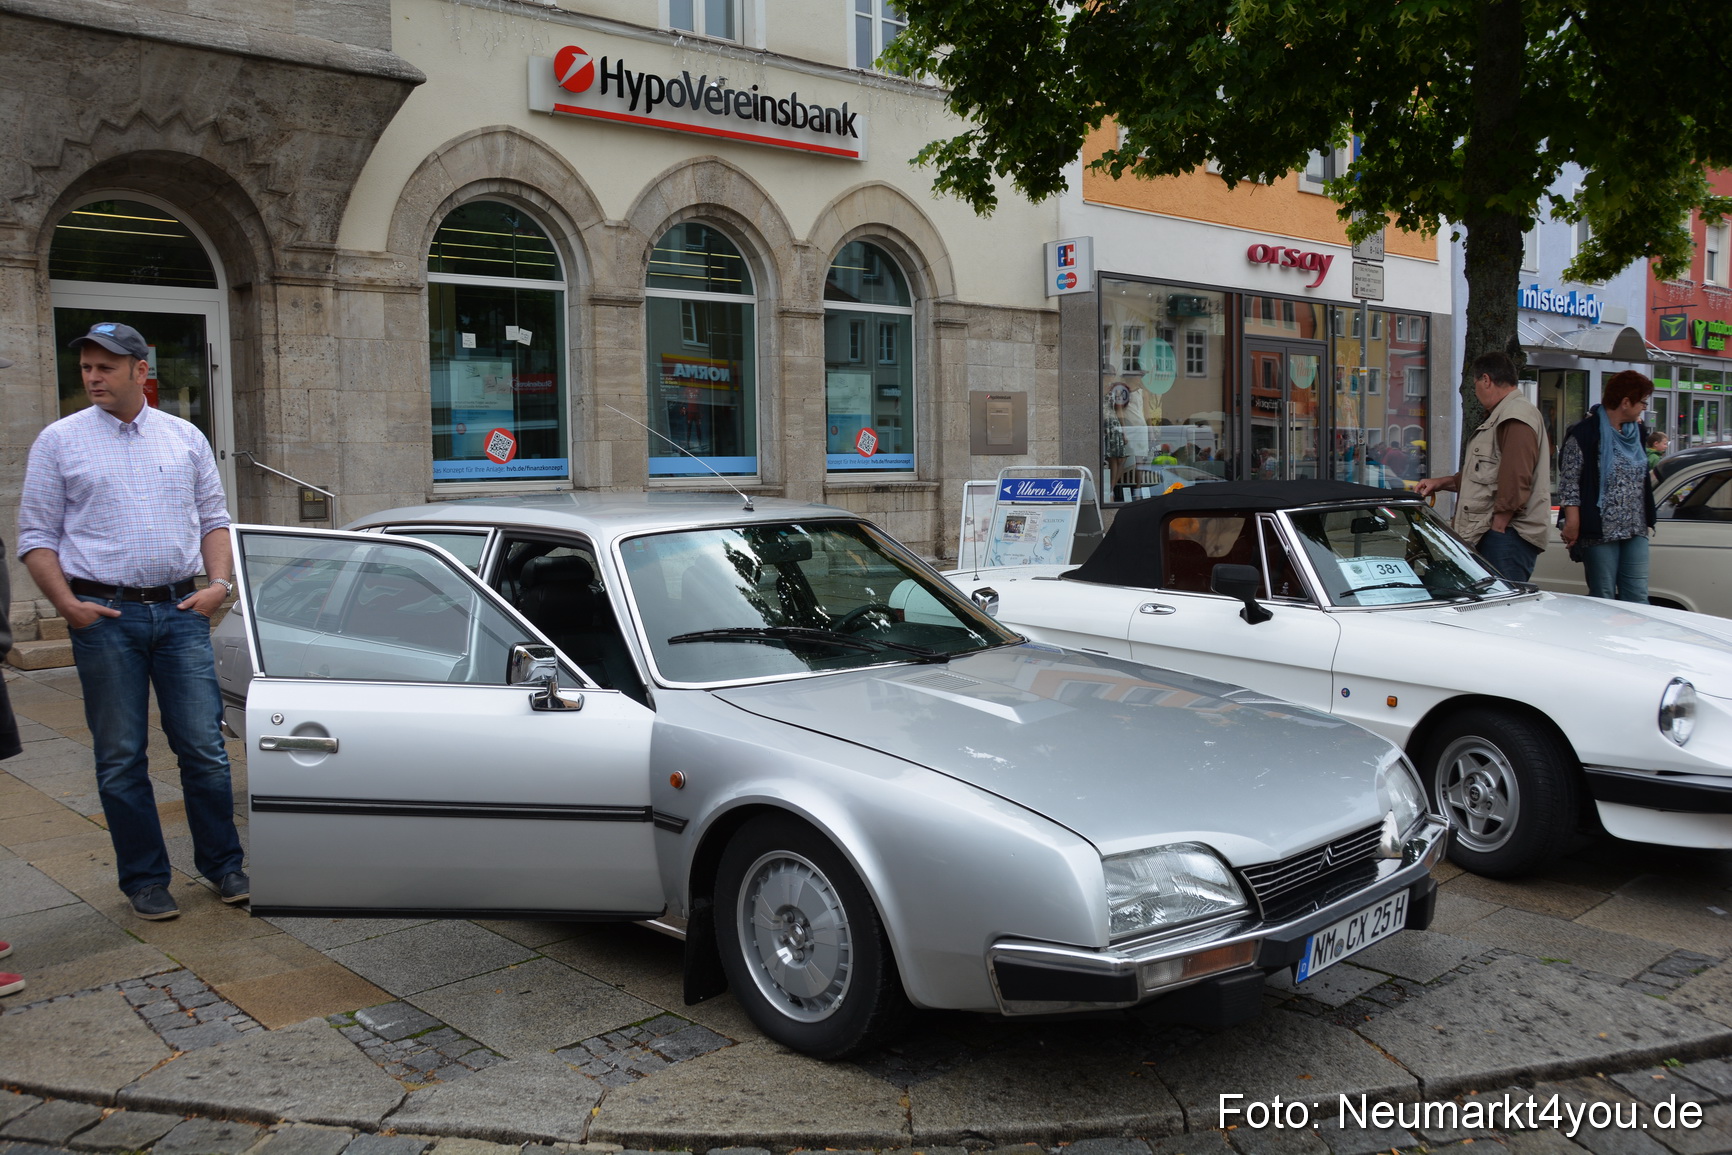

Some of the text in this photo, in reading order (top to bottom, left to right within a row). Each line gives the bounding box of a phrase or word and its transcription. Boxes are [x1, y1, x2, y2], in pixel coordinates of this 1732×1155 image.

[600, 55, 859, 139] HypoVereinsbank
[1247, 243, 1335, 289] orsay
[1521, 284, 1605, 325] mister lady
[443, 466, 465, 474] Konzept
[465, 465, 474, 473] für
[475, 465, 485, 473] Ihre
[486, 465, 505, 474] Anlage:
[506, 464, 563, 472] hvb.de/finanzkonzept
[1016, 480, 1079, 500] Uhren Stang
[1376, 563, 1402, 575] 381
[1312, 928, 1337, 969] NM
[1346, 912, 1369, 951] CX
[1301, 962, 1307, 973] D
